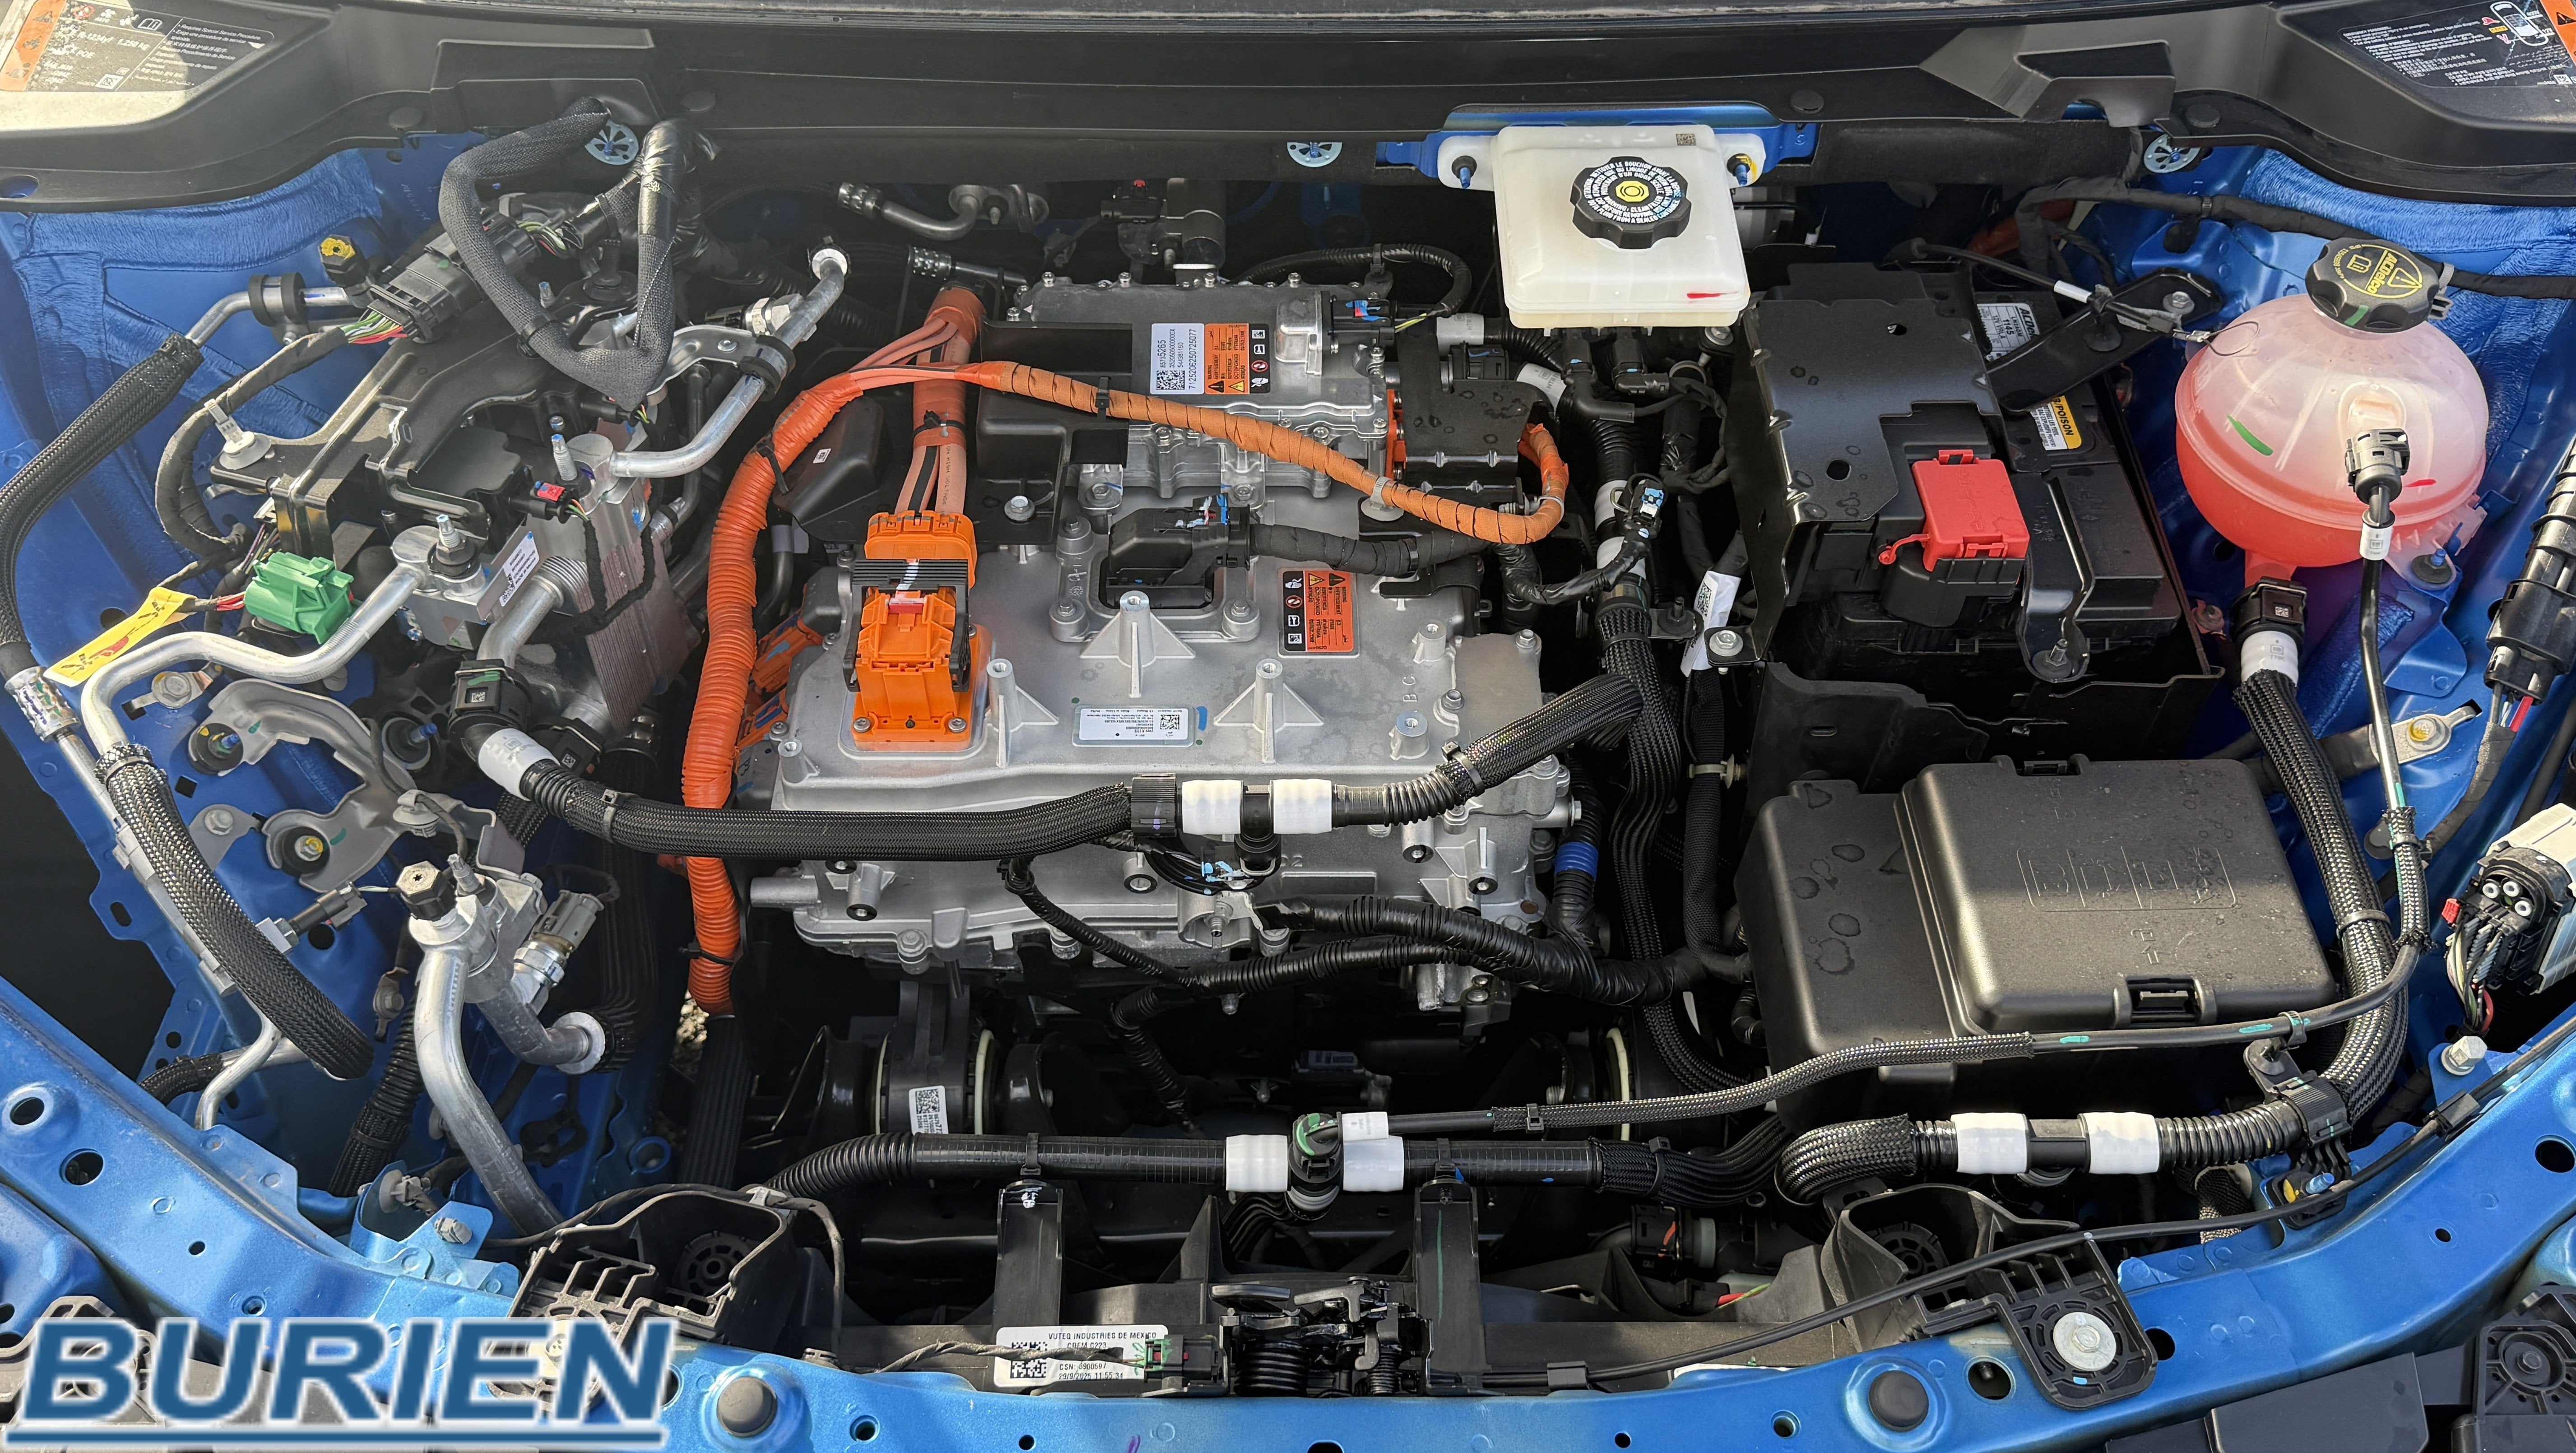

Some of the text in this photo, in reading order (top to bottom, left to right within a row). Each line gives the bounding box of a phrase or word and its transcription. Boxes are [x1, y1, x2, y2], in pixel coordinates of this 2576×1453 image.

[1625, 161, 1652, 170] BOUCHON
[1630, 204, 1650, 213] CLEAN
[1612, 215, 1631, 223] FROM
[2367, 252, 2398, 294] ACDelco
[2003, 319, 2014, 335] 1145
[2019, 308, 2038, 337] ACDel
[942, 476, 950, 506] VOLTAGE
